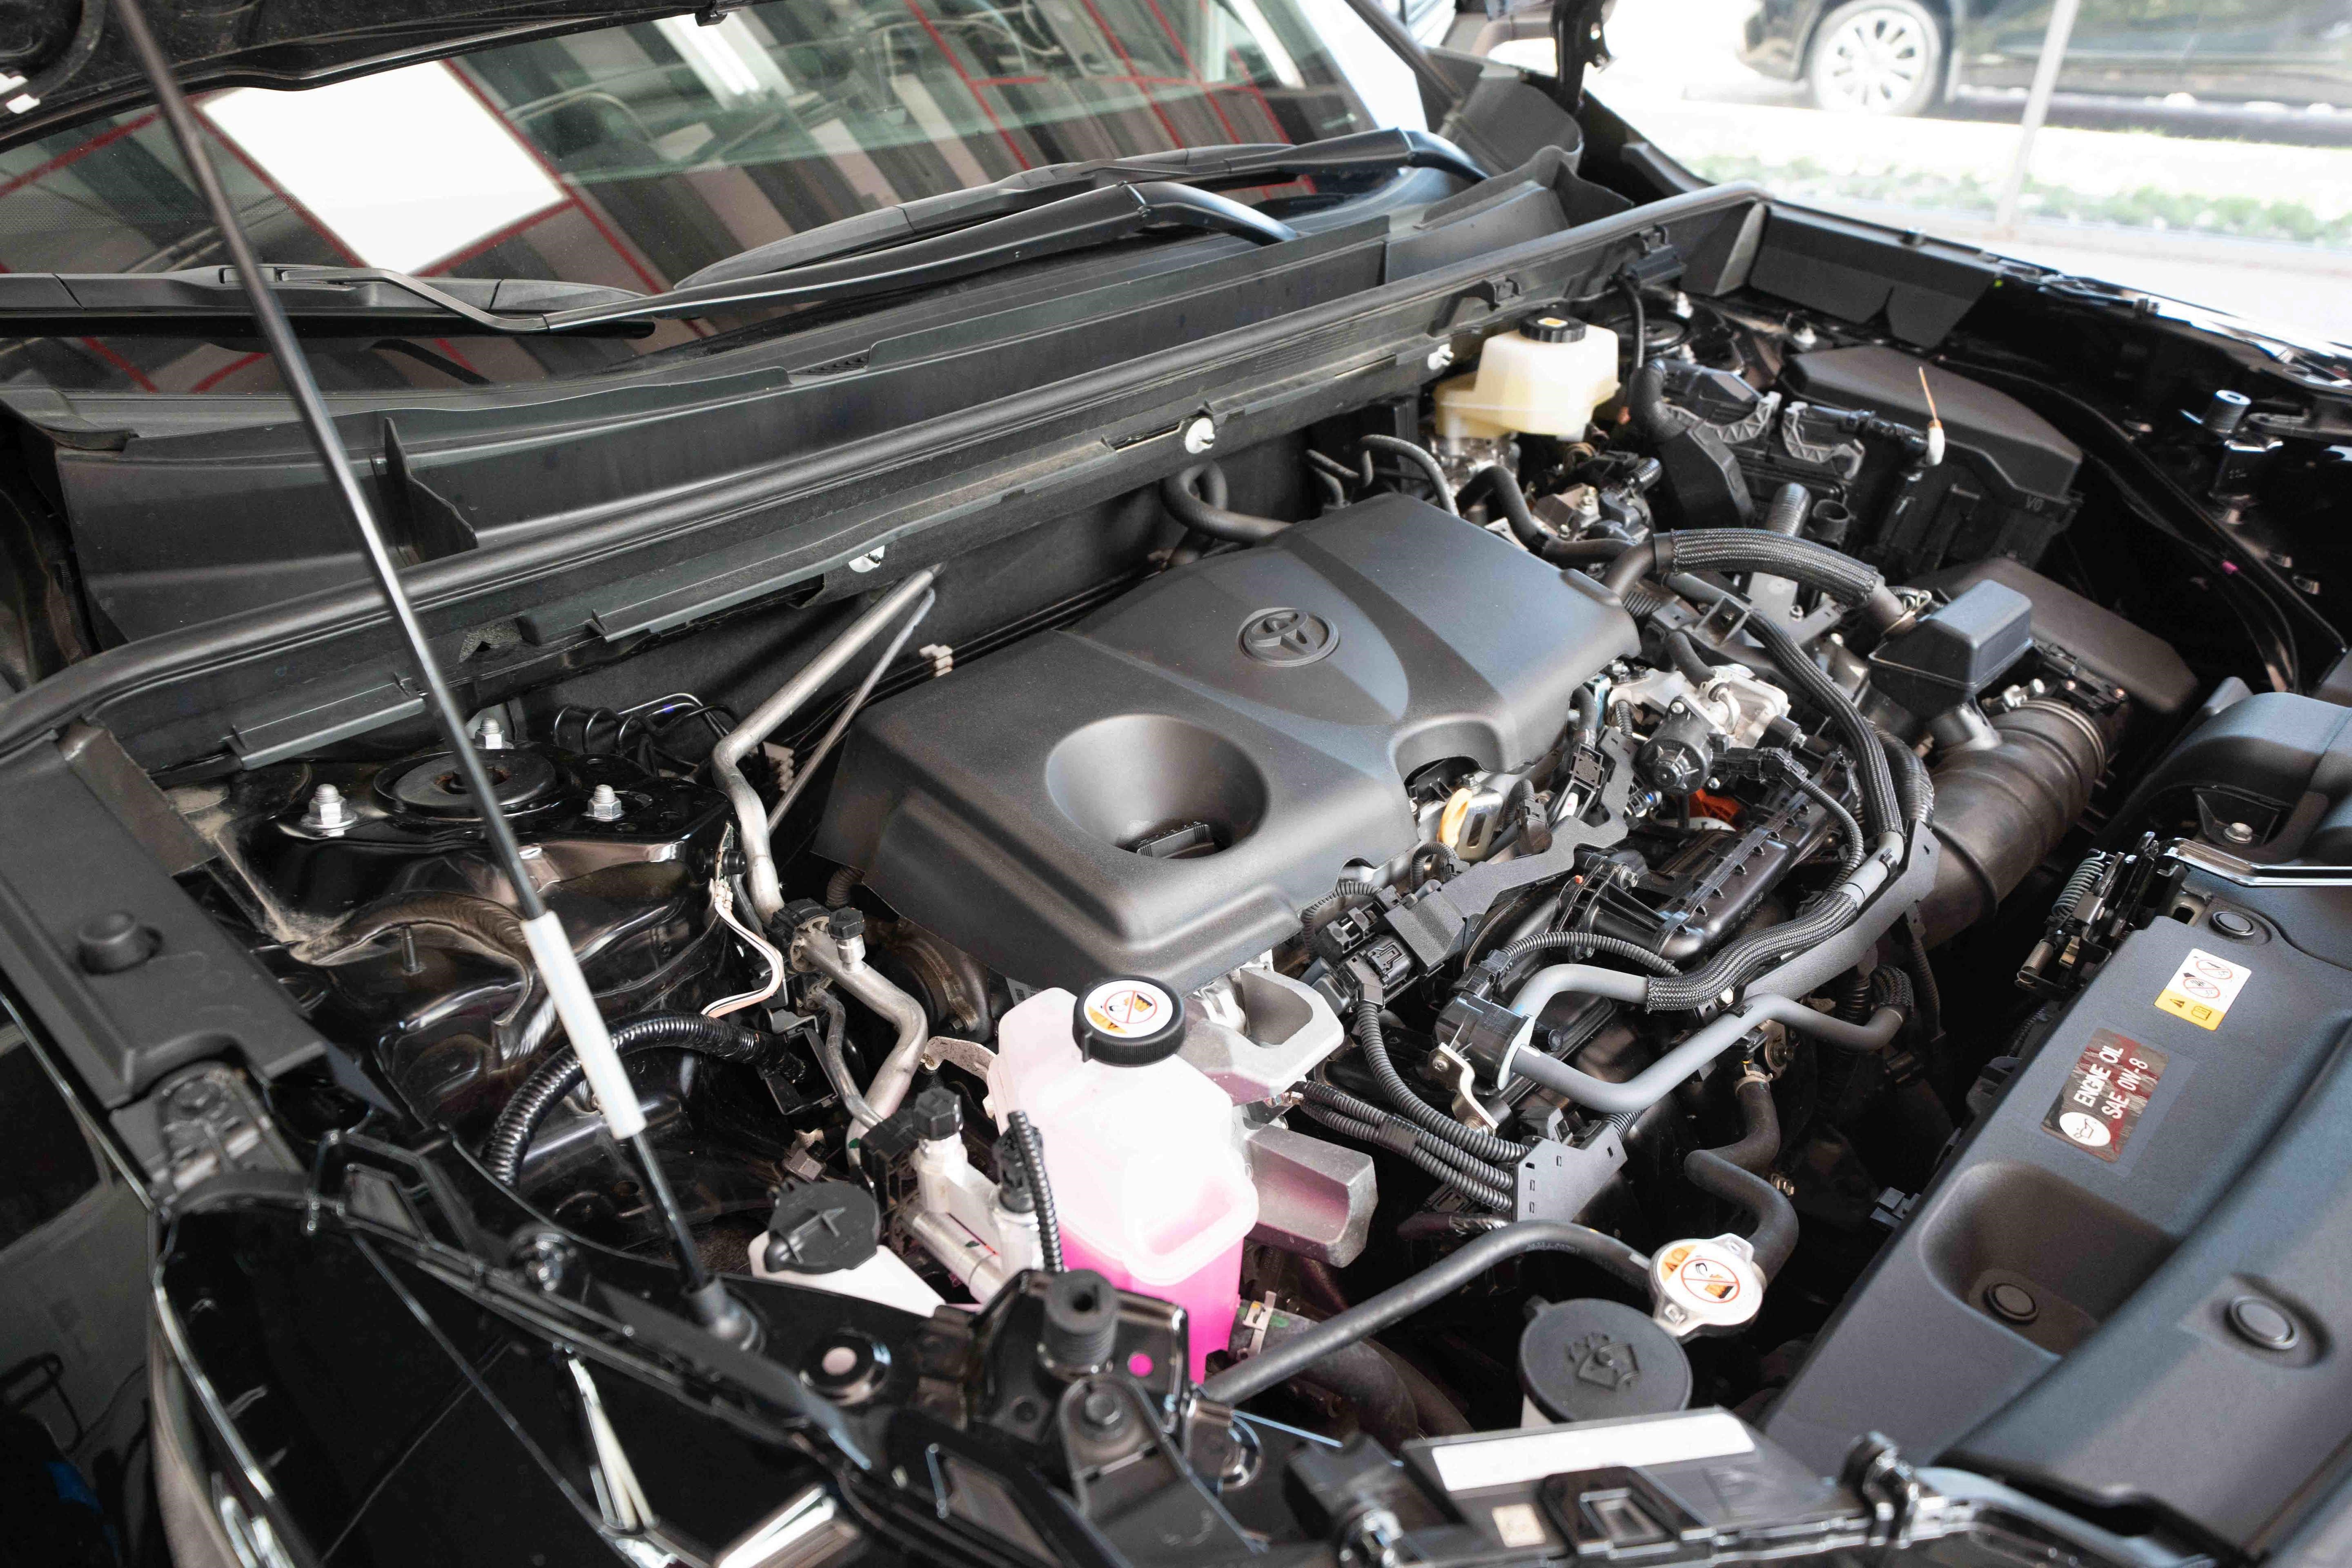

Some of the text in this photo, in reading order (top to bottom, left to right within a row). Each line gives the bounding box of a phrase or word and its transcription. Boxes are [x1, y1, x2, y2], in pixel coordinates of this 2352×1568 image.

[2074, 1045, 2124, 1107] ENGINE OIL
[2101, 1058, 2148, 1119] SAE 0W-8
